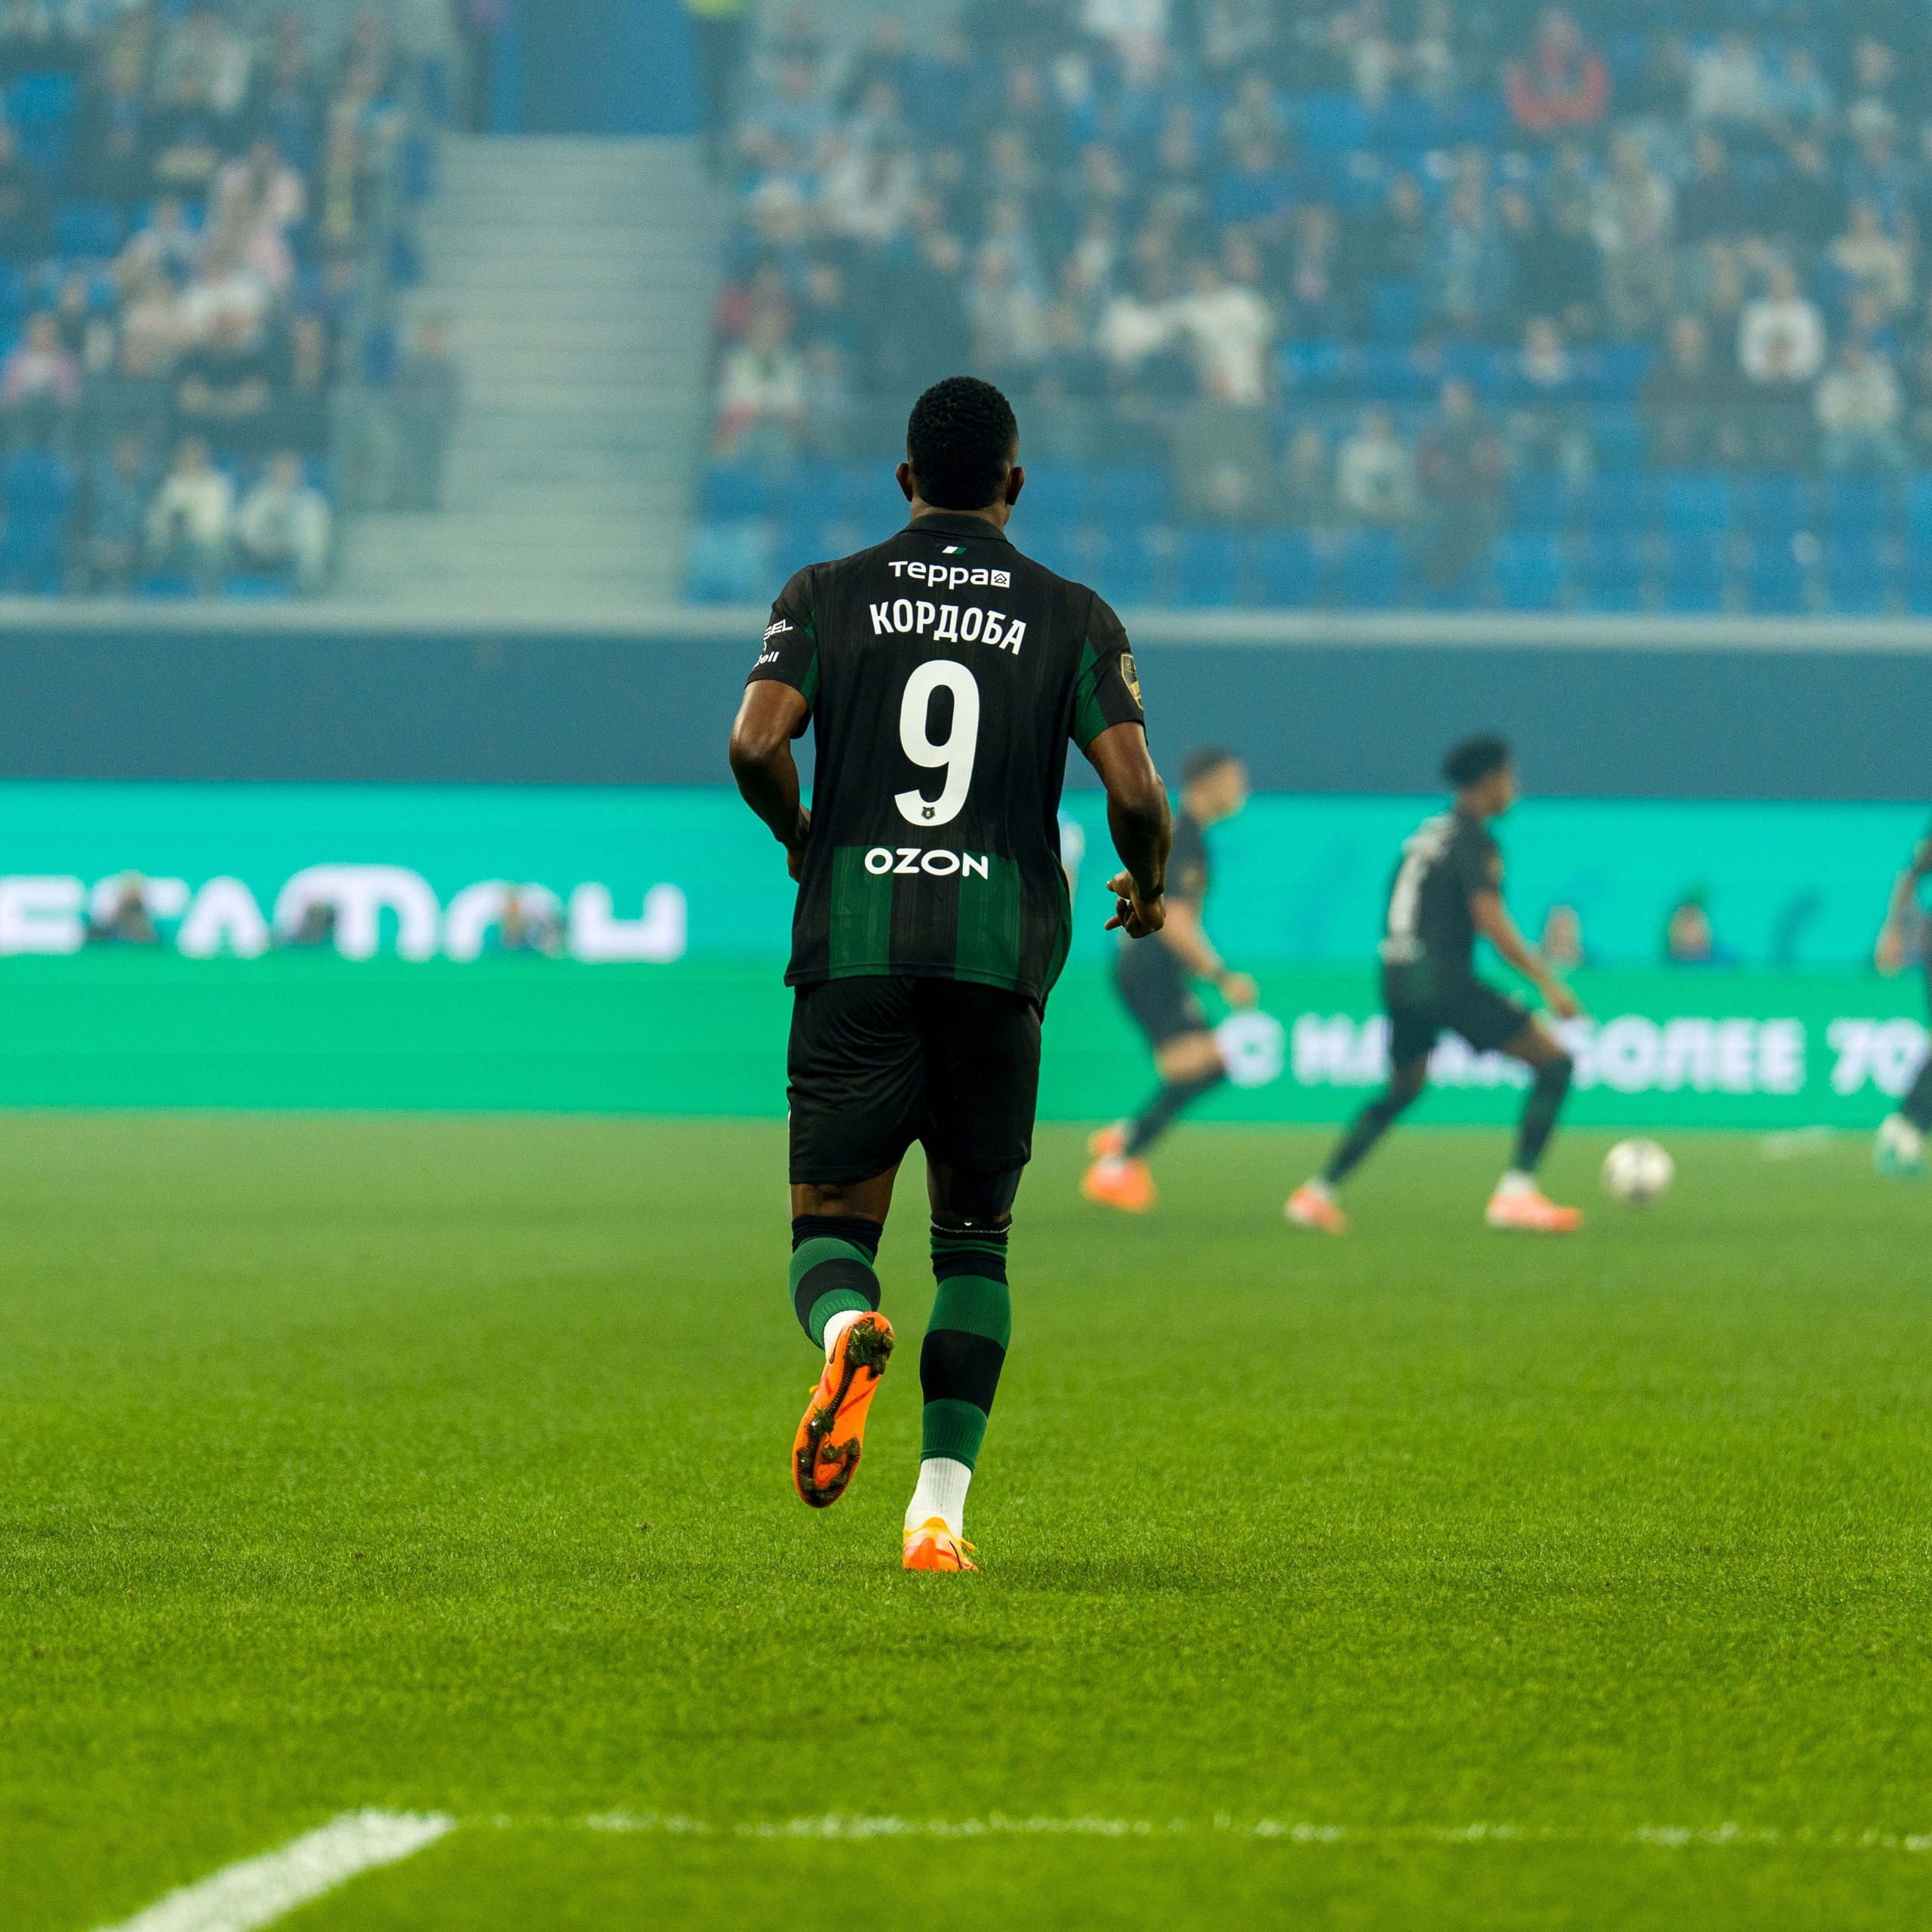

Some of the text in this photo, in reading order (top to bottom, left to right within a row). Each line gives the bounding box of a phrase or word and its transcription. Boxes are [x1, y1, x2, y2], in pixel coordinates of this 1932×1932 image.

[888, 560, 989, 590] терра
[869, 598, 1027, 655] КОРДОБА
[894, 660, 980, 826] 9
[864, 848, 989, 880] OZON
